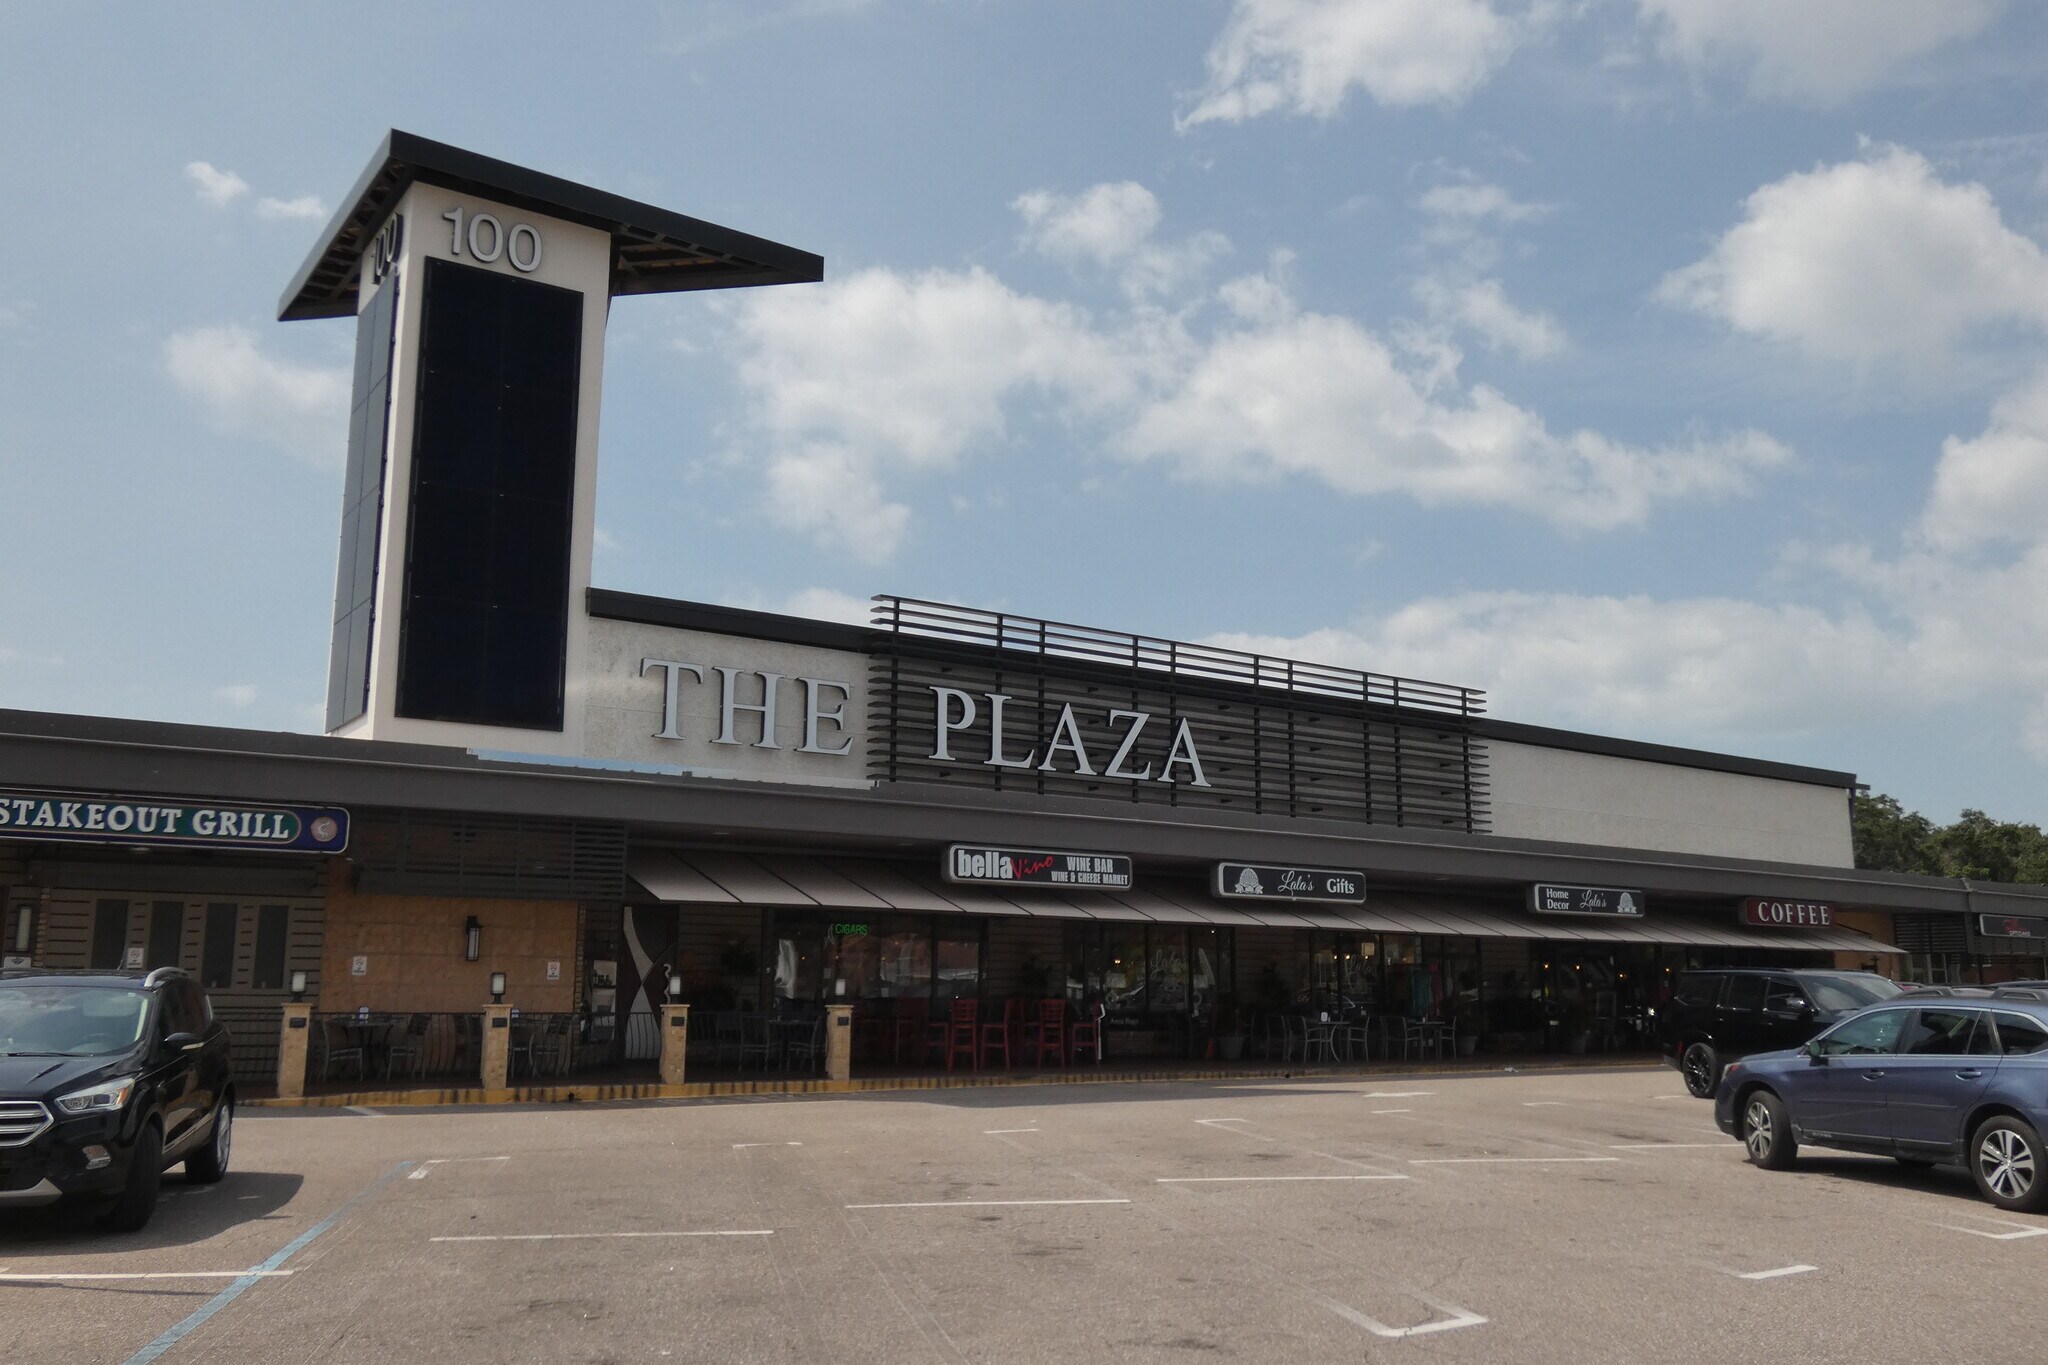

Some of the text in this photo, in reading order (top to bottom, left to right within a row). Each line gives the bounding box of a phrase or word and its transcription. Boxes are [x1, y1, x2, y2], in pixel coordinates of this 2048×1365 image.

[443, 206, 541, 272] 100
[640, 657, 1211, 787] THE PLAZA
[0, 798, 289, 839] STAKEOUT GRILL
[957, 849, 1053, 879] bella Vino
[1066, 856, 1113, 873] WINE BAR
[1051, 871, 1068, 882] WINE
[1077, 873, 1101, 884] CHEESE
[1102, 874, 1128, 885] MARKET
[1326, 878, 1355, 894] Gifts
[1546, 888, 1569, 899] Home
[1547, 899, 1569, 910] Decor
[1758, 902, 1830, 925] COFFEE
[835, 923, 868, 937] CIGARS
